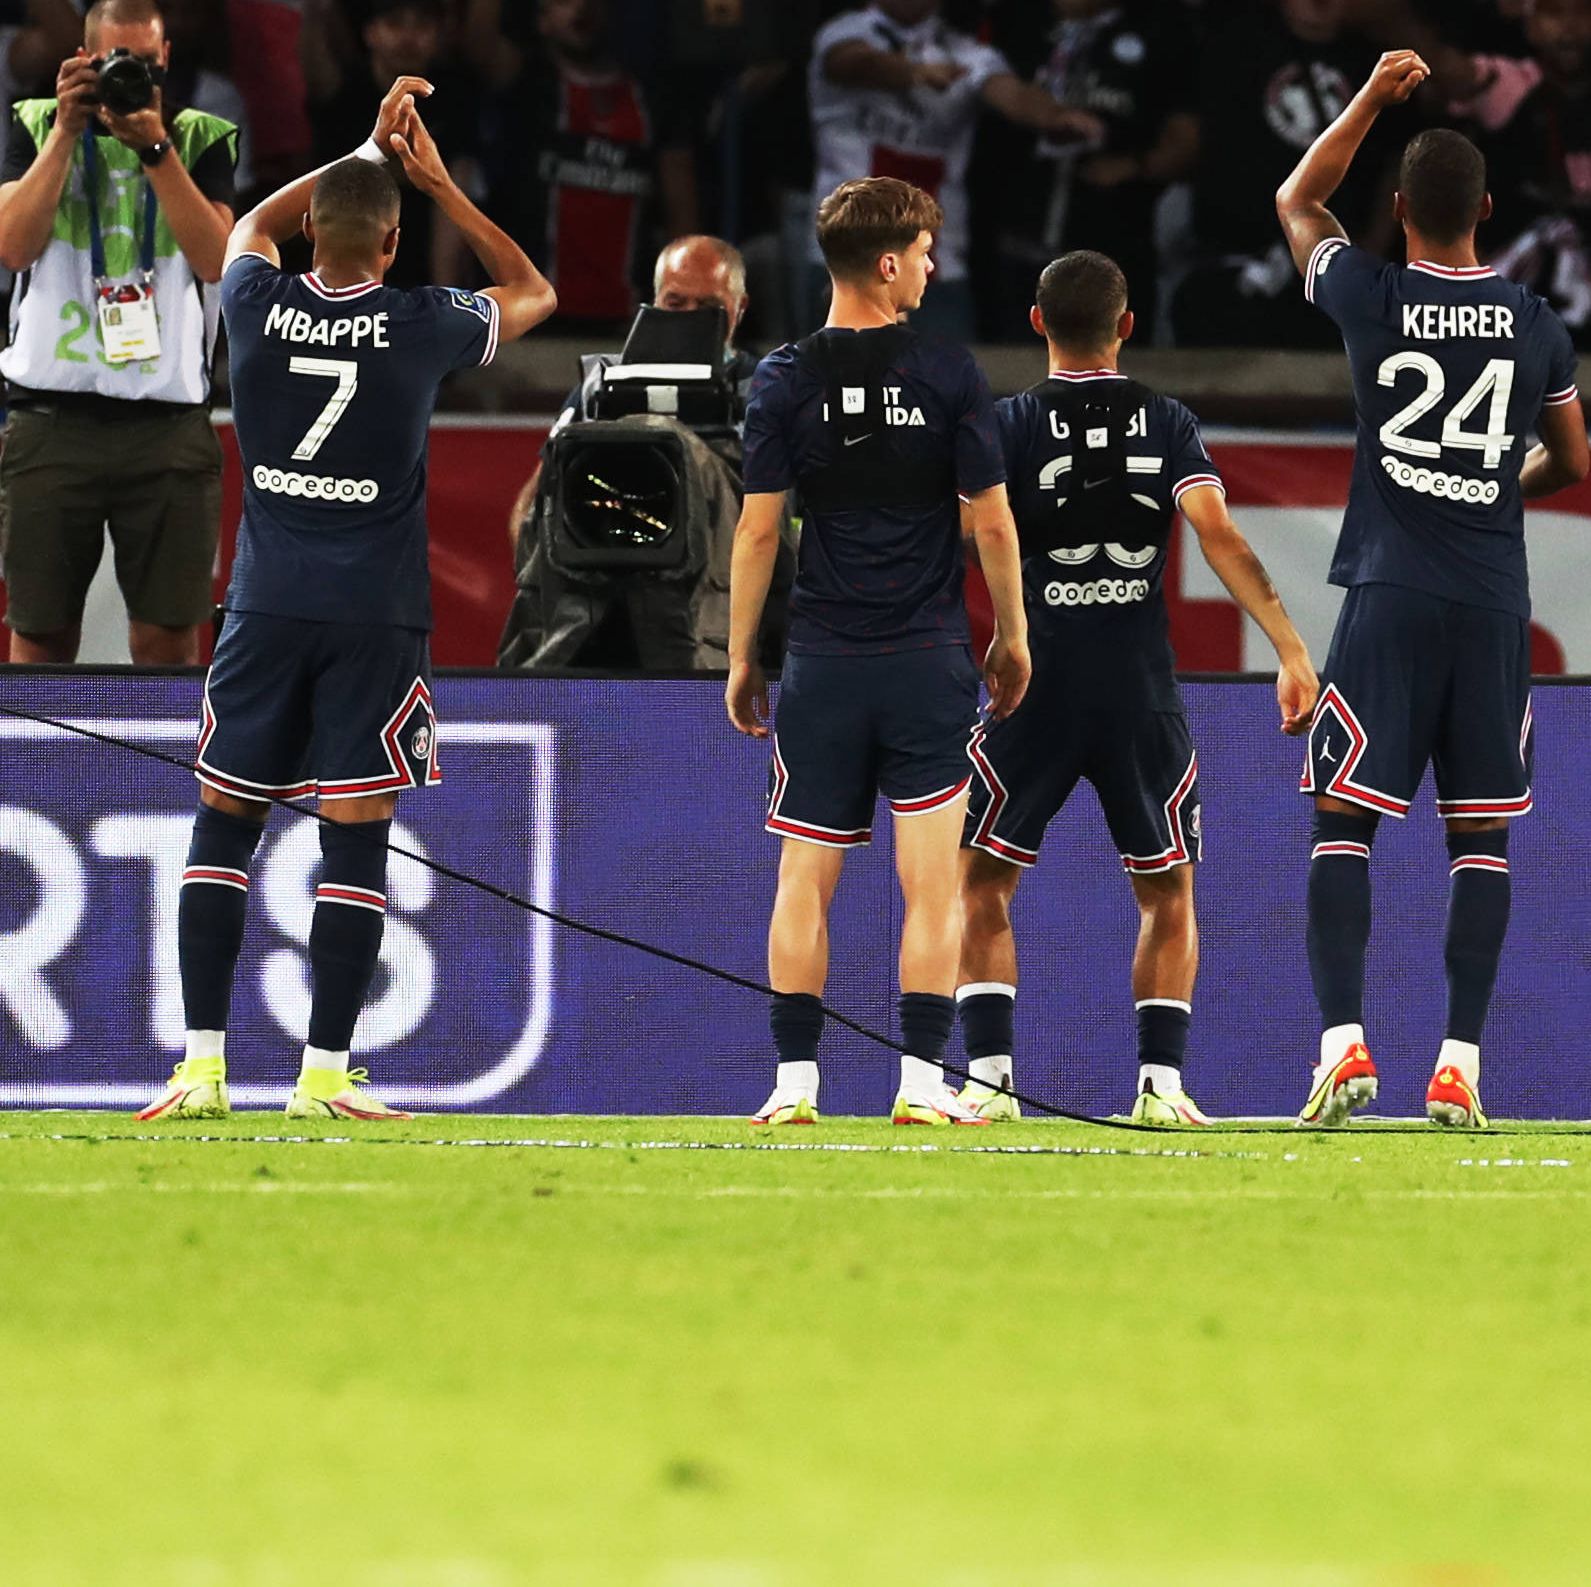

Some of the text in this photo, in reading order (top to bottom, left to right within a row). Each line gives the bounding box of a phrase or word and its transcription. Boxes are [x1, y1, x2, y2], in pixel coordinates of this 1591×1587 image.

[264, 303, 390, 348] MBAPPÉ
[1403, 304, 1515, 340] KEHRER
[289, 356, 358, 461] 7
[1376, 351, 1516, 469] 24
[254, 466, 378, 502] ooredoo
[1382, 456, 1500, 504] ooredoo
